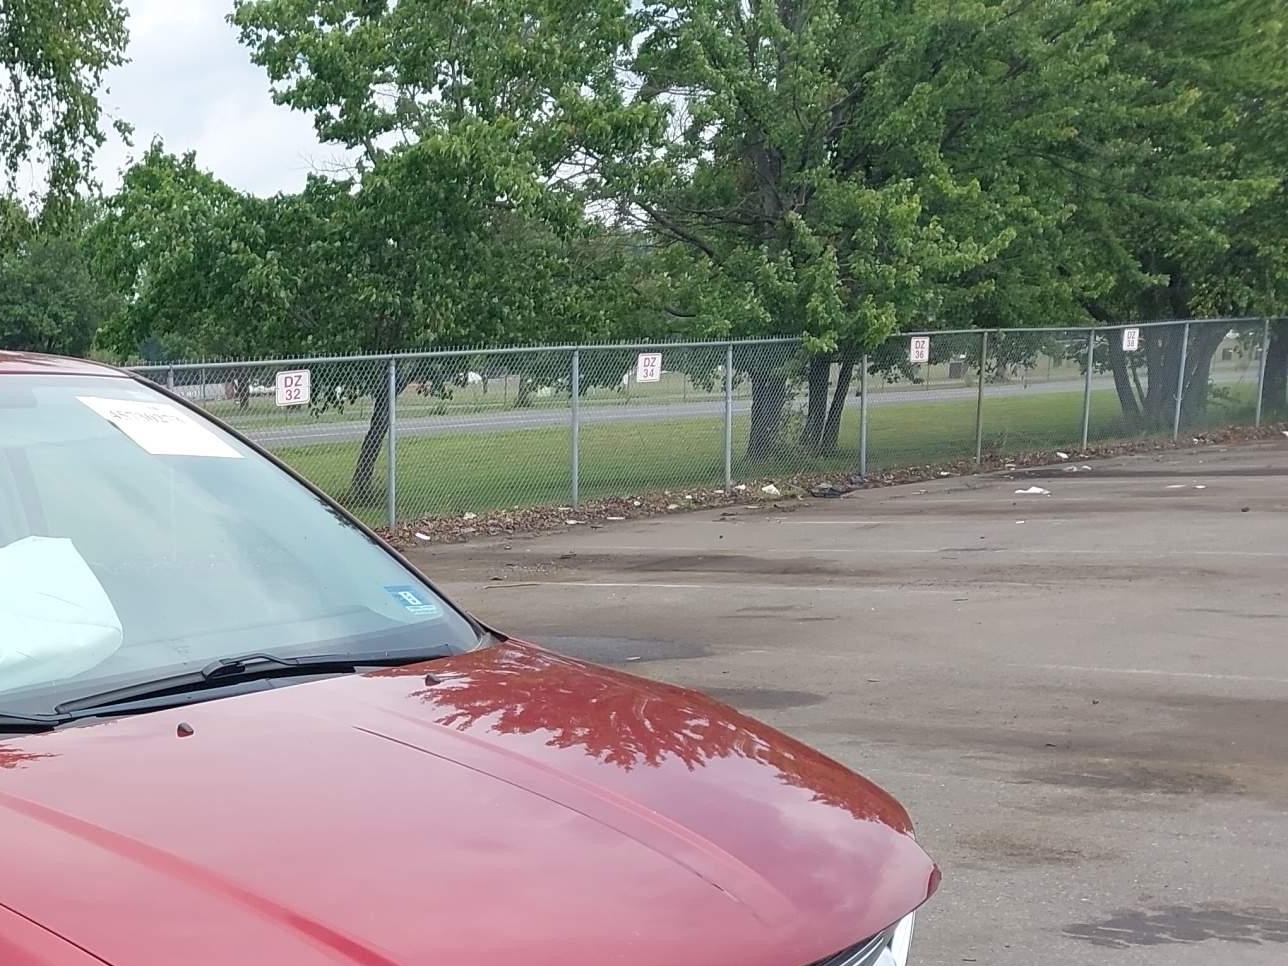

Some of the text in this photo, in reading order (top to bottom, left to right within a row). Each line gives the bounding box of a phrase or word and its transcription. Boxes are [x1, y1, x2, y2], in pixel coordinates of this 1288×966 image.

[915, 340, 926, 349] DZ
[915, 350, 924, 359] 36
[643, 357, 657, 367] DZ
[643, 369, 654, 378] 34
[284, 375, 303, 388] DZ
[285, 388, 301, 401] 32
